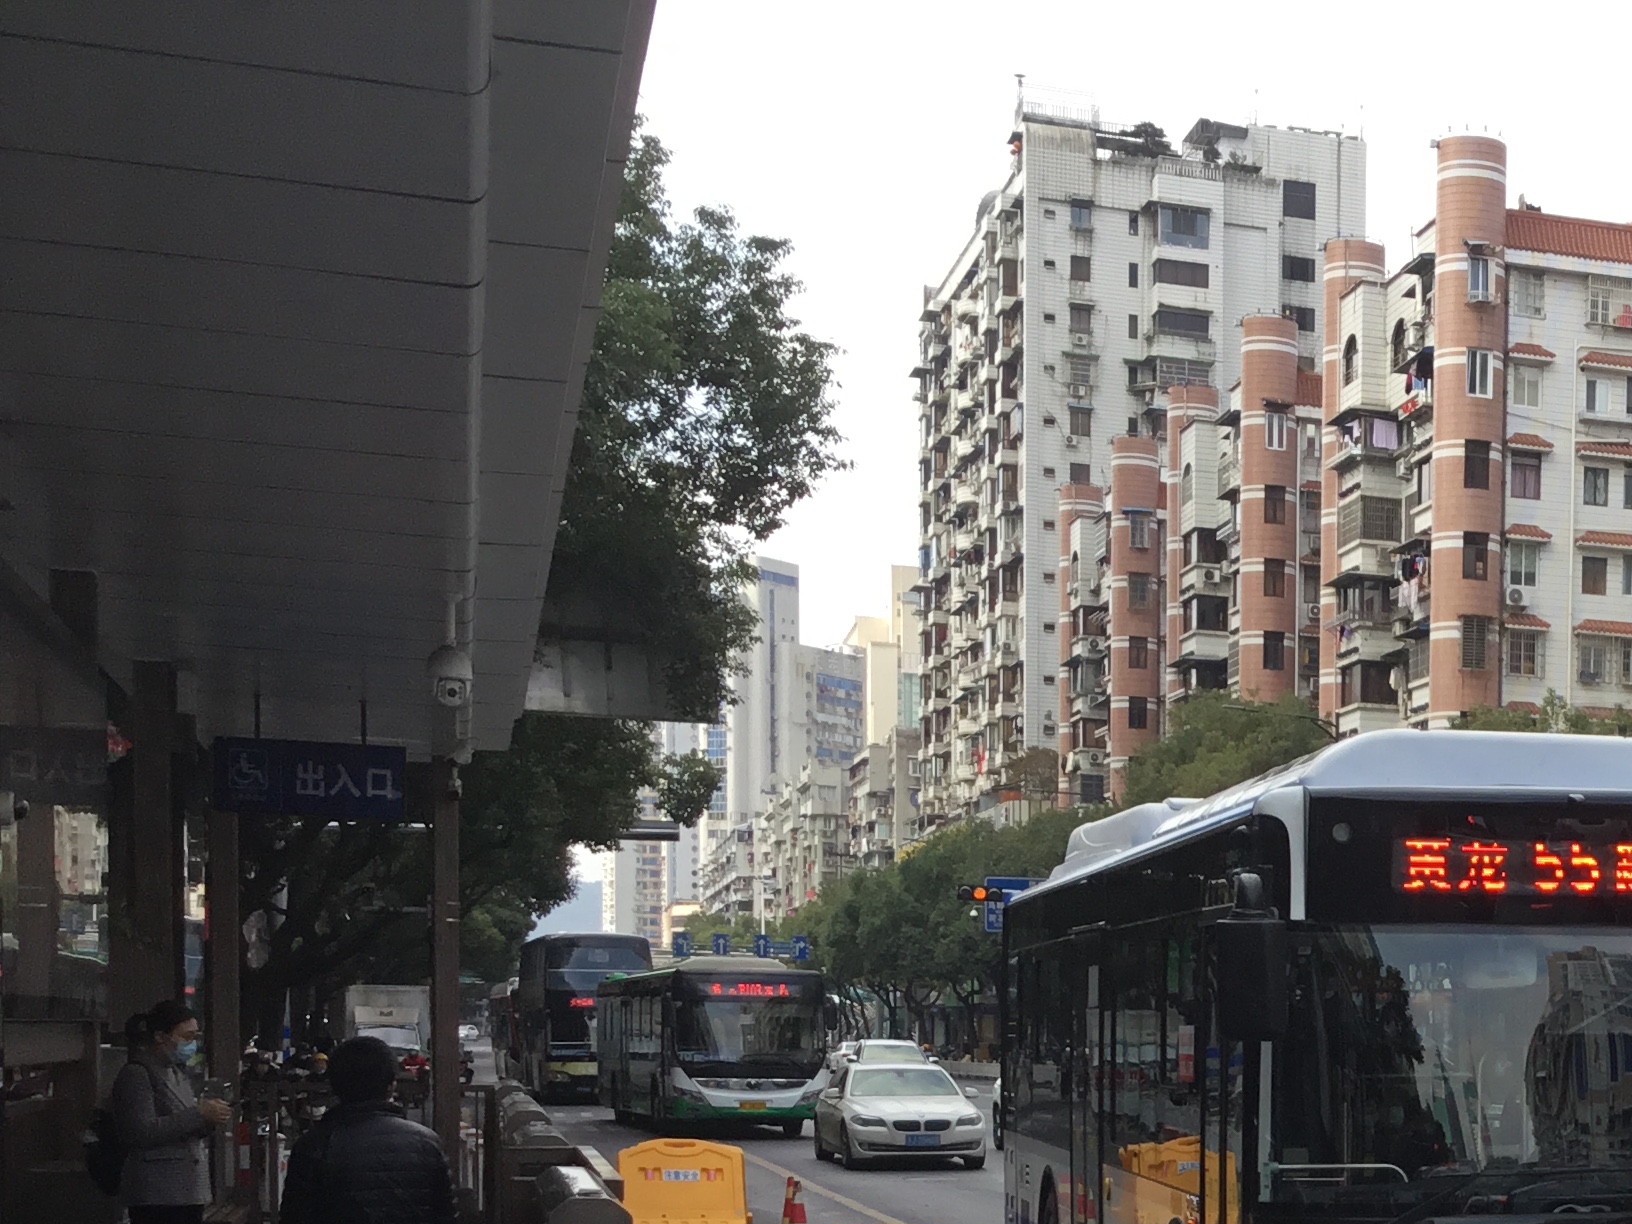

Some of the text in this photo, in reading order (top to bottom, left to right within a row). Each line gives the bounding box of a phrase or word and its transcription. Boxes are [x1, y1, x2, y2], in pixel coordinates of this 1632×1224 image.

[296, 761, 394, 798] 出入口
[1534, 843, 1600, 892] 55
